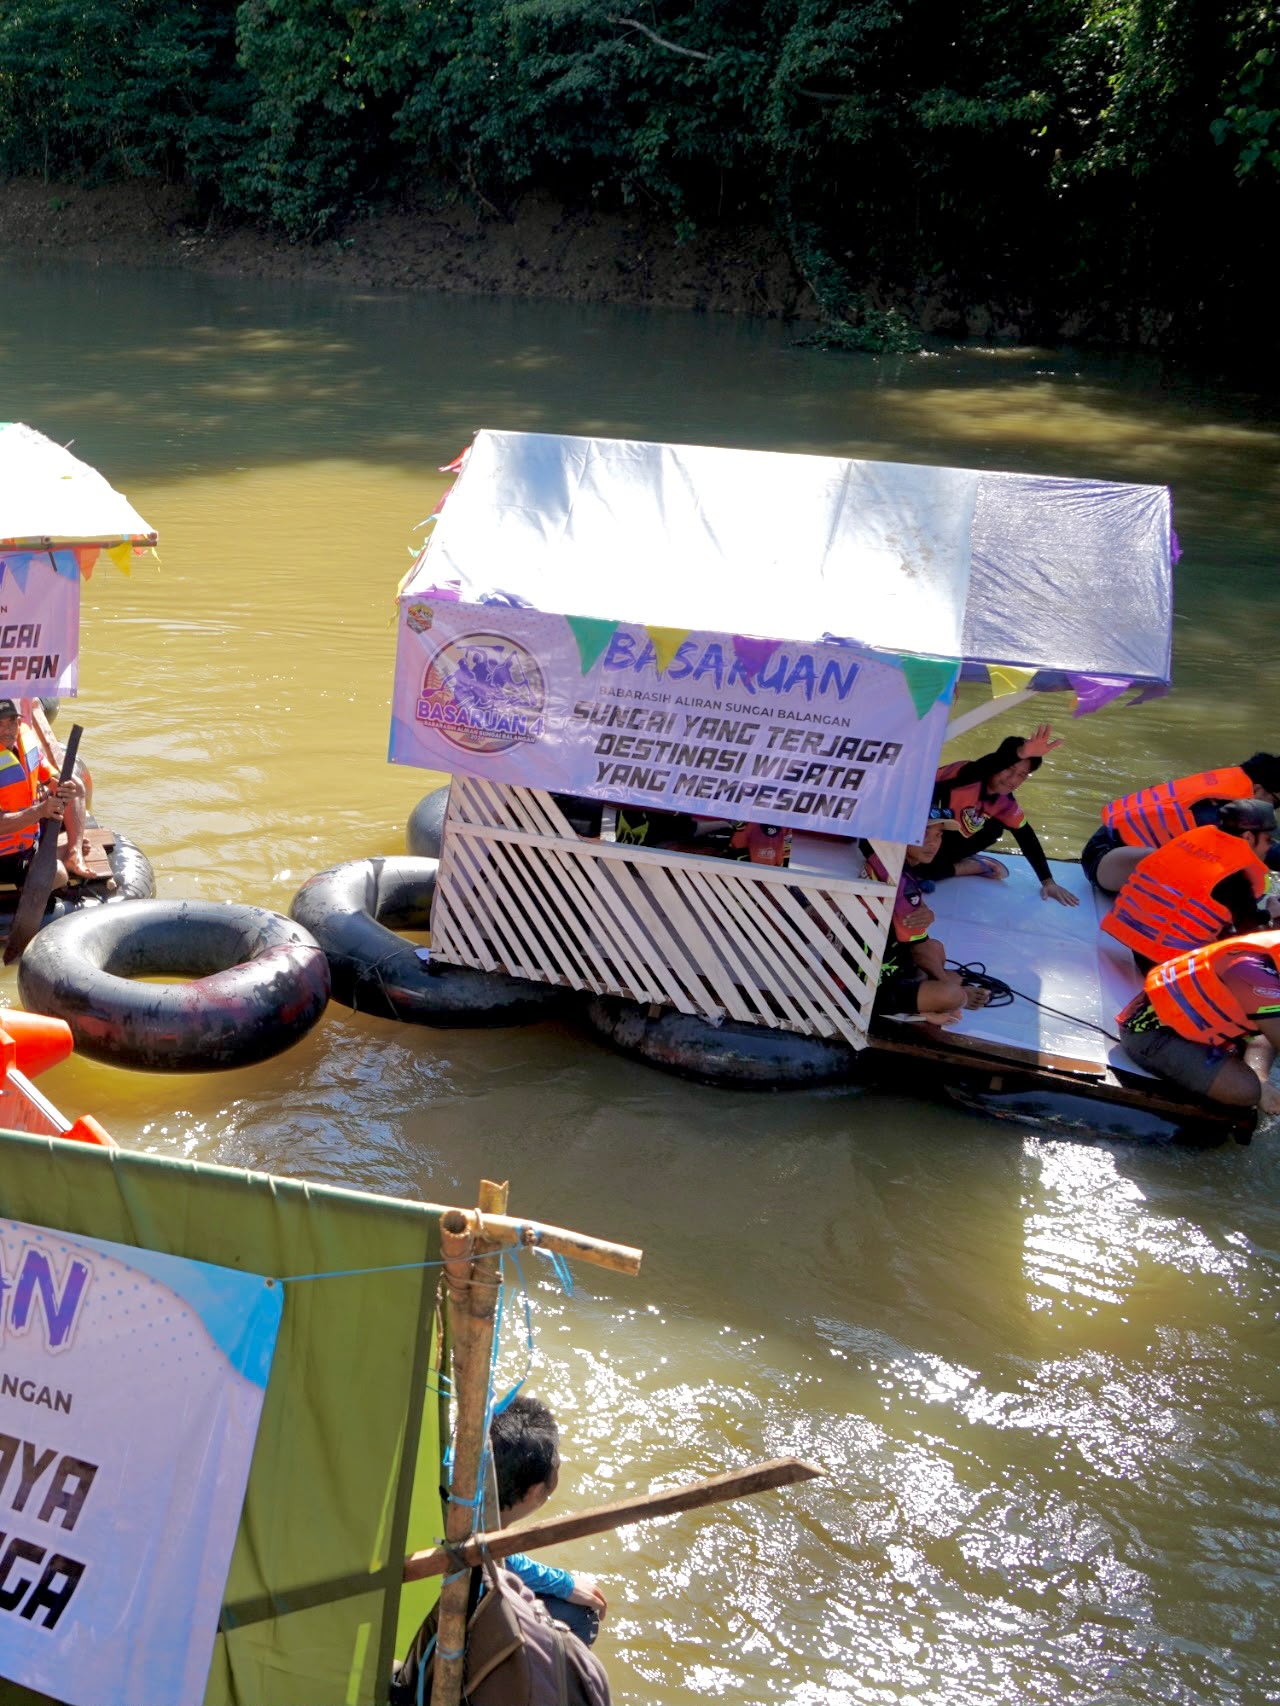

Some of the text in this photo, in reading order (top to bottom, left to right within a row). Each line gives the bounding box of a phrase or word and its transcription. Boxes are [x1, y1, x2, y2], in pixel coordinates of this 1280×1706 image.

[417, 700, 545, 736] BASARUAN 4
[572, 700, 903, 766] SUNGAI YANG TERJAGA
[600, 687, 851, 727] BABARASIH ALIRAN SUNGAI BALANGAN
[594, 733, 866, 791] DESTINASI WISATA
[596, 761, 858, 821] YANG MEMPESONA
